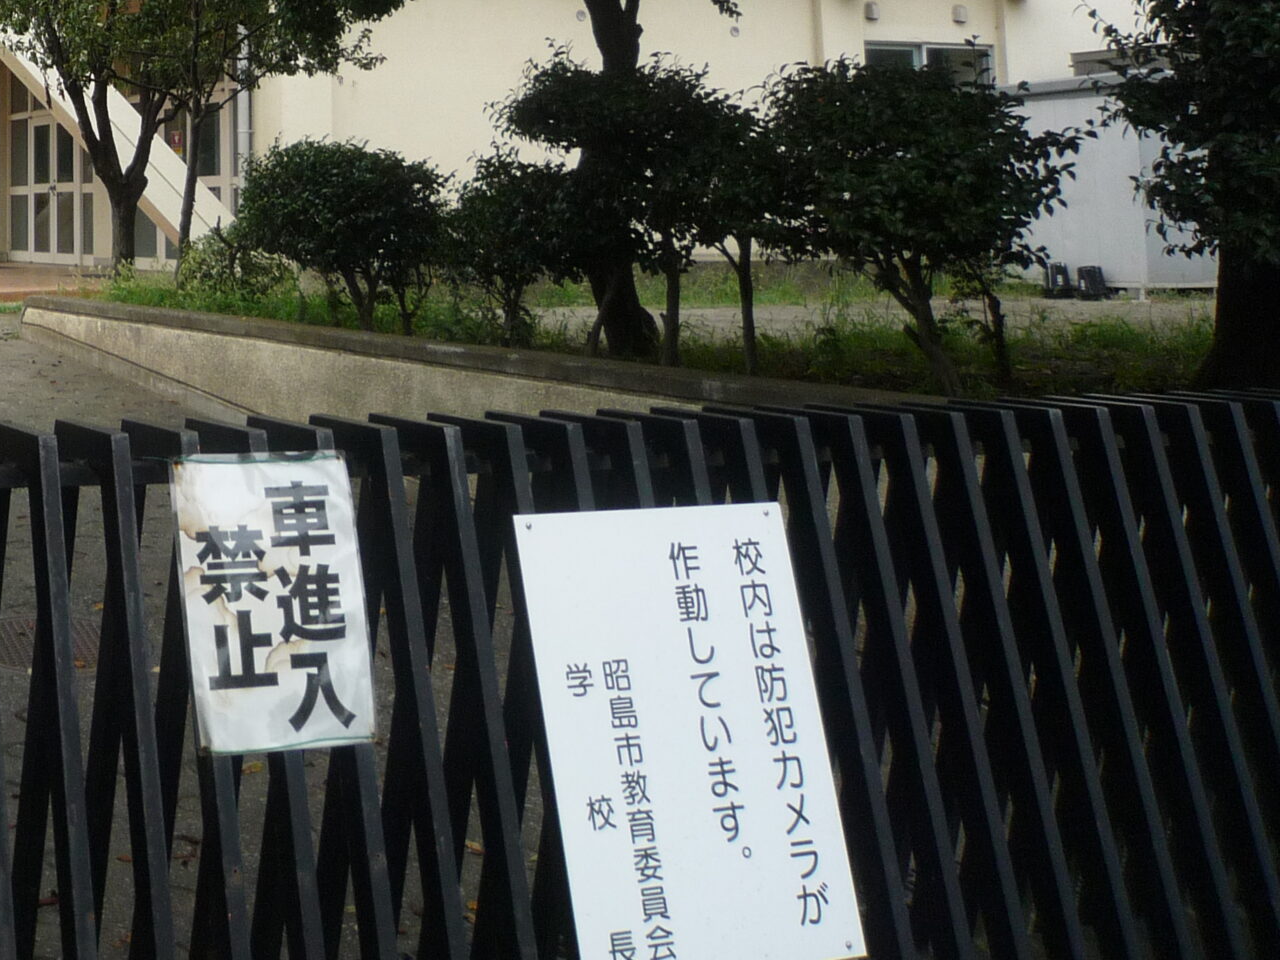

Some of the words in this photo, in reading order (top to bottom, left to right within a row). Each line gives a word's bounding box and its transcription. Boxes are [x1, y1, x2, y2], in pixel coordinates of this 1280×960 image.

[195, 524, 280, 691] 禁止
[265, 480, 357, 733] 車進入
[668, 541, 752, 860] 作動しています。
[732, 537, 829, 927] 校内は防犯カメラが
[602, 658, 677, 960] 昭島市教育委員会
